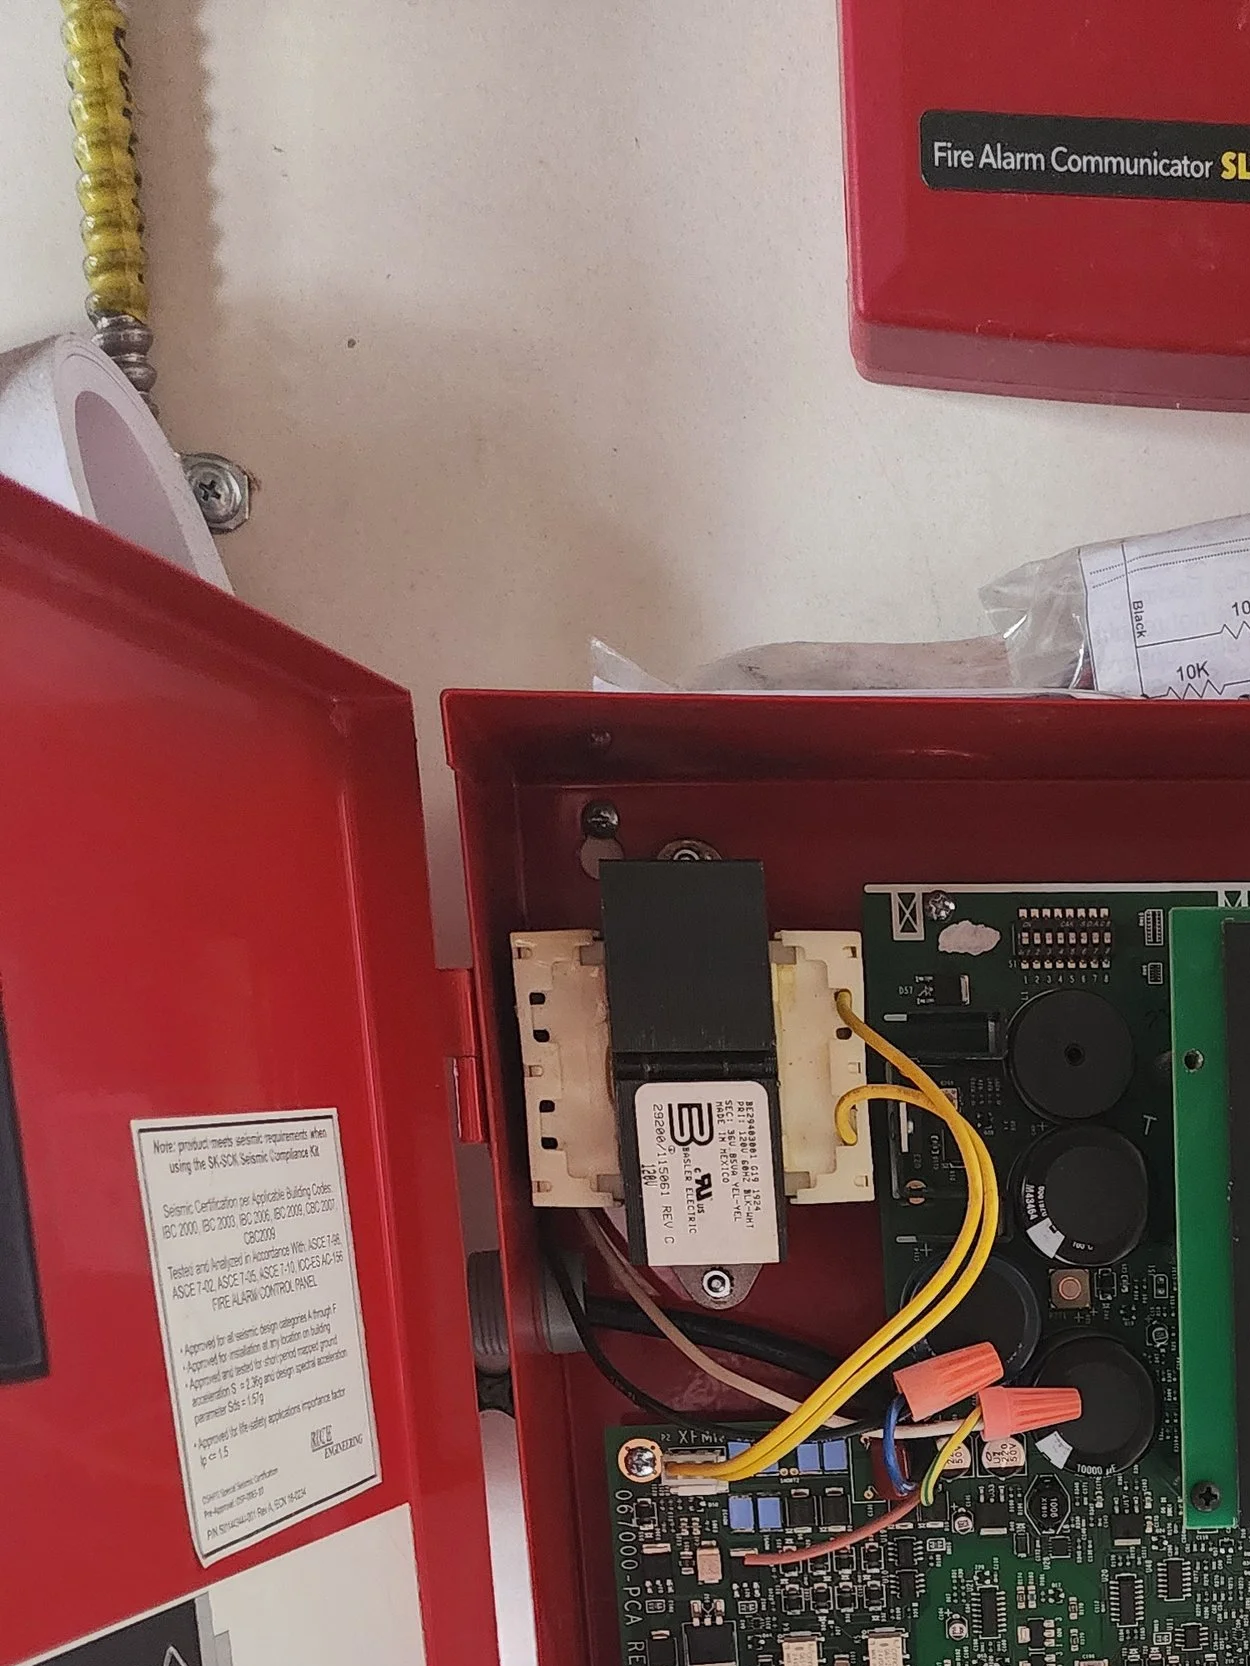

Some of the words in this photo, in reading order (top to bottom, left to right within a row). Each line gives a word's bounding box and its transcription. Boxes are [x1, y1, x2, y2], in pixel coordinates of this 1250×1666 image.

[933, 142, 974, 169] Fire
[979, 144, 1046, 172] Alarm
[1051, 146, 1213, 178] Communicator
[1131, 600, 1148, 638] Black
[1175, 661, 1210, 681] 10K
[716, 1101, 725, 1125] MADE
[682, 1147, 692, 1182] BASLER
[720, 1148, 730, 1184] MEXICO
[662, 1205, 673, 1229] REV
[685, 1187, 697, 1234] ELECTRIC
[664, 1236, 675, 1245] C
[212, 1296, 231, 1311] FIRE
[232, 1291, 258, 1306] ALARM
[259, 1280, 294, 1300] CONTROL
[295, 1275, 318, 1289] PANEL
[615, 1490, 643, 1626] 067000-PCA
